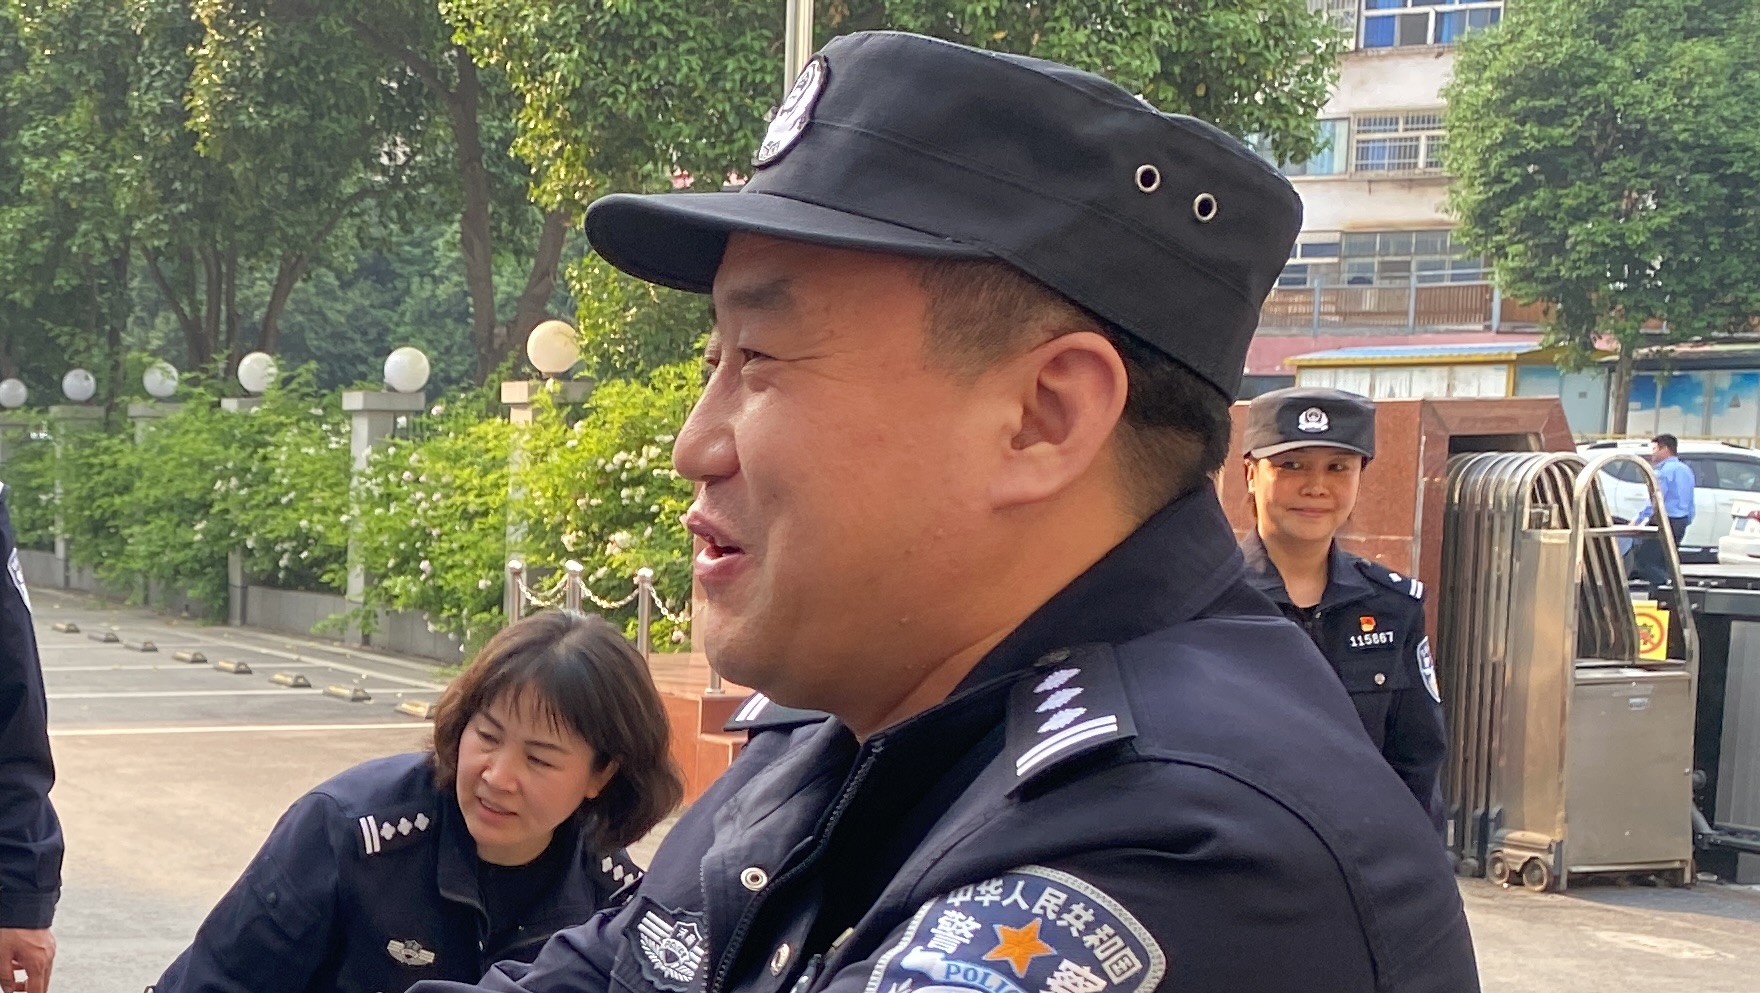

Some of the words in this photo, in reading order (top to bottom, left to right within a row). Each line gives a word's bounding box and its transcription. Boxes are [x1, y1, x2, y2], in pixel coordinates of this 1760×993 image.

[1350, 631, 1394, 647] 115867
[946, 877, 1143, 986] 中华人民共和国
